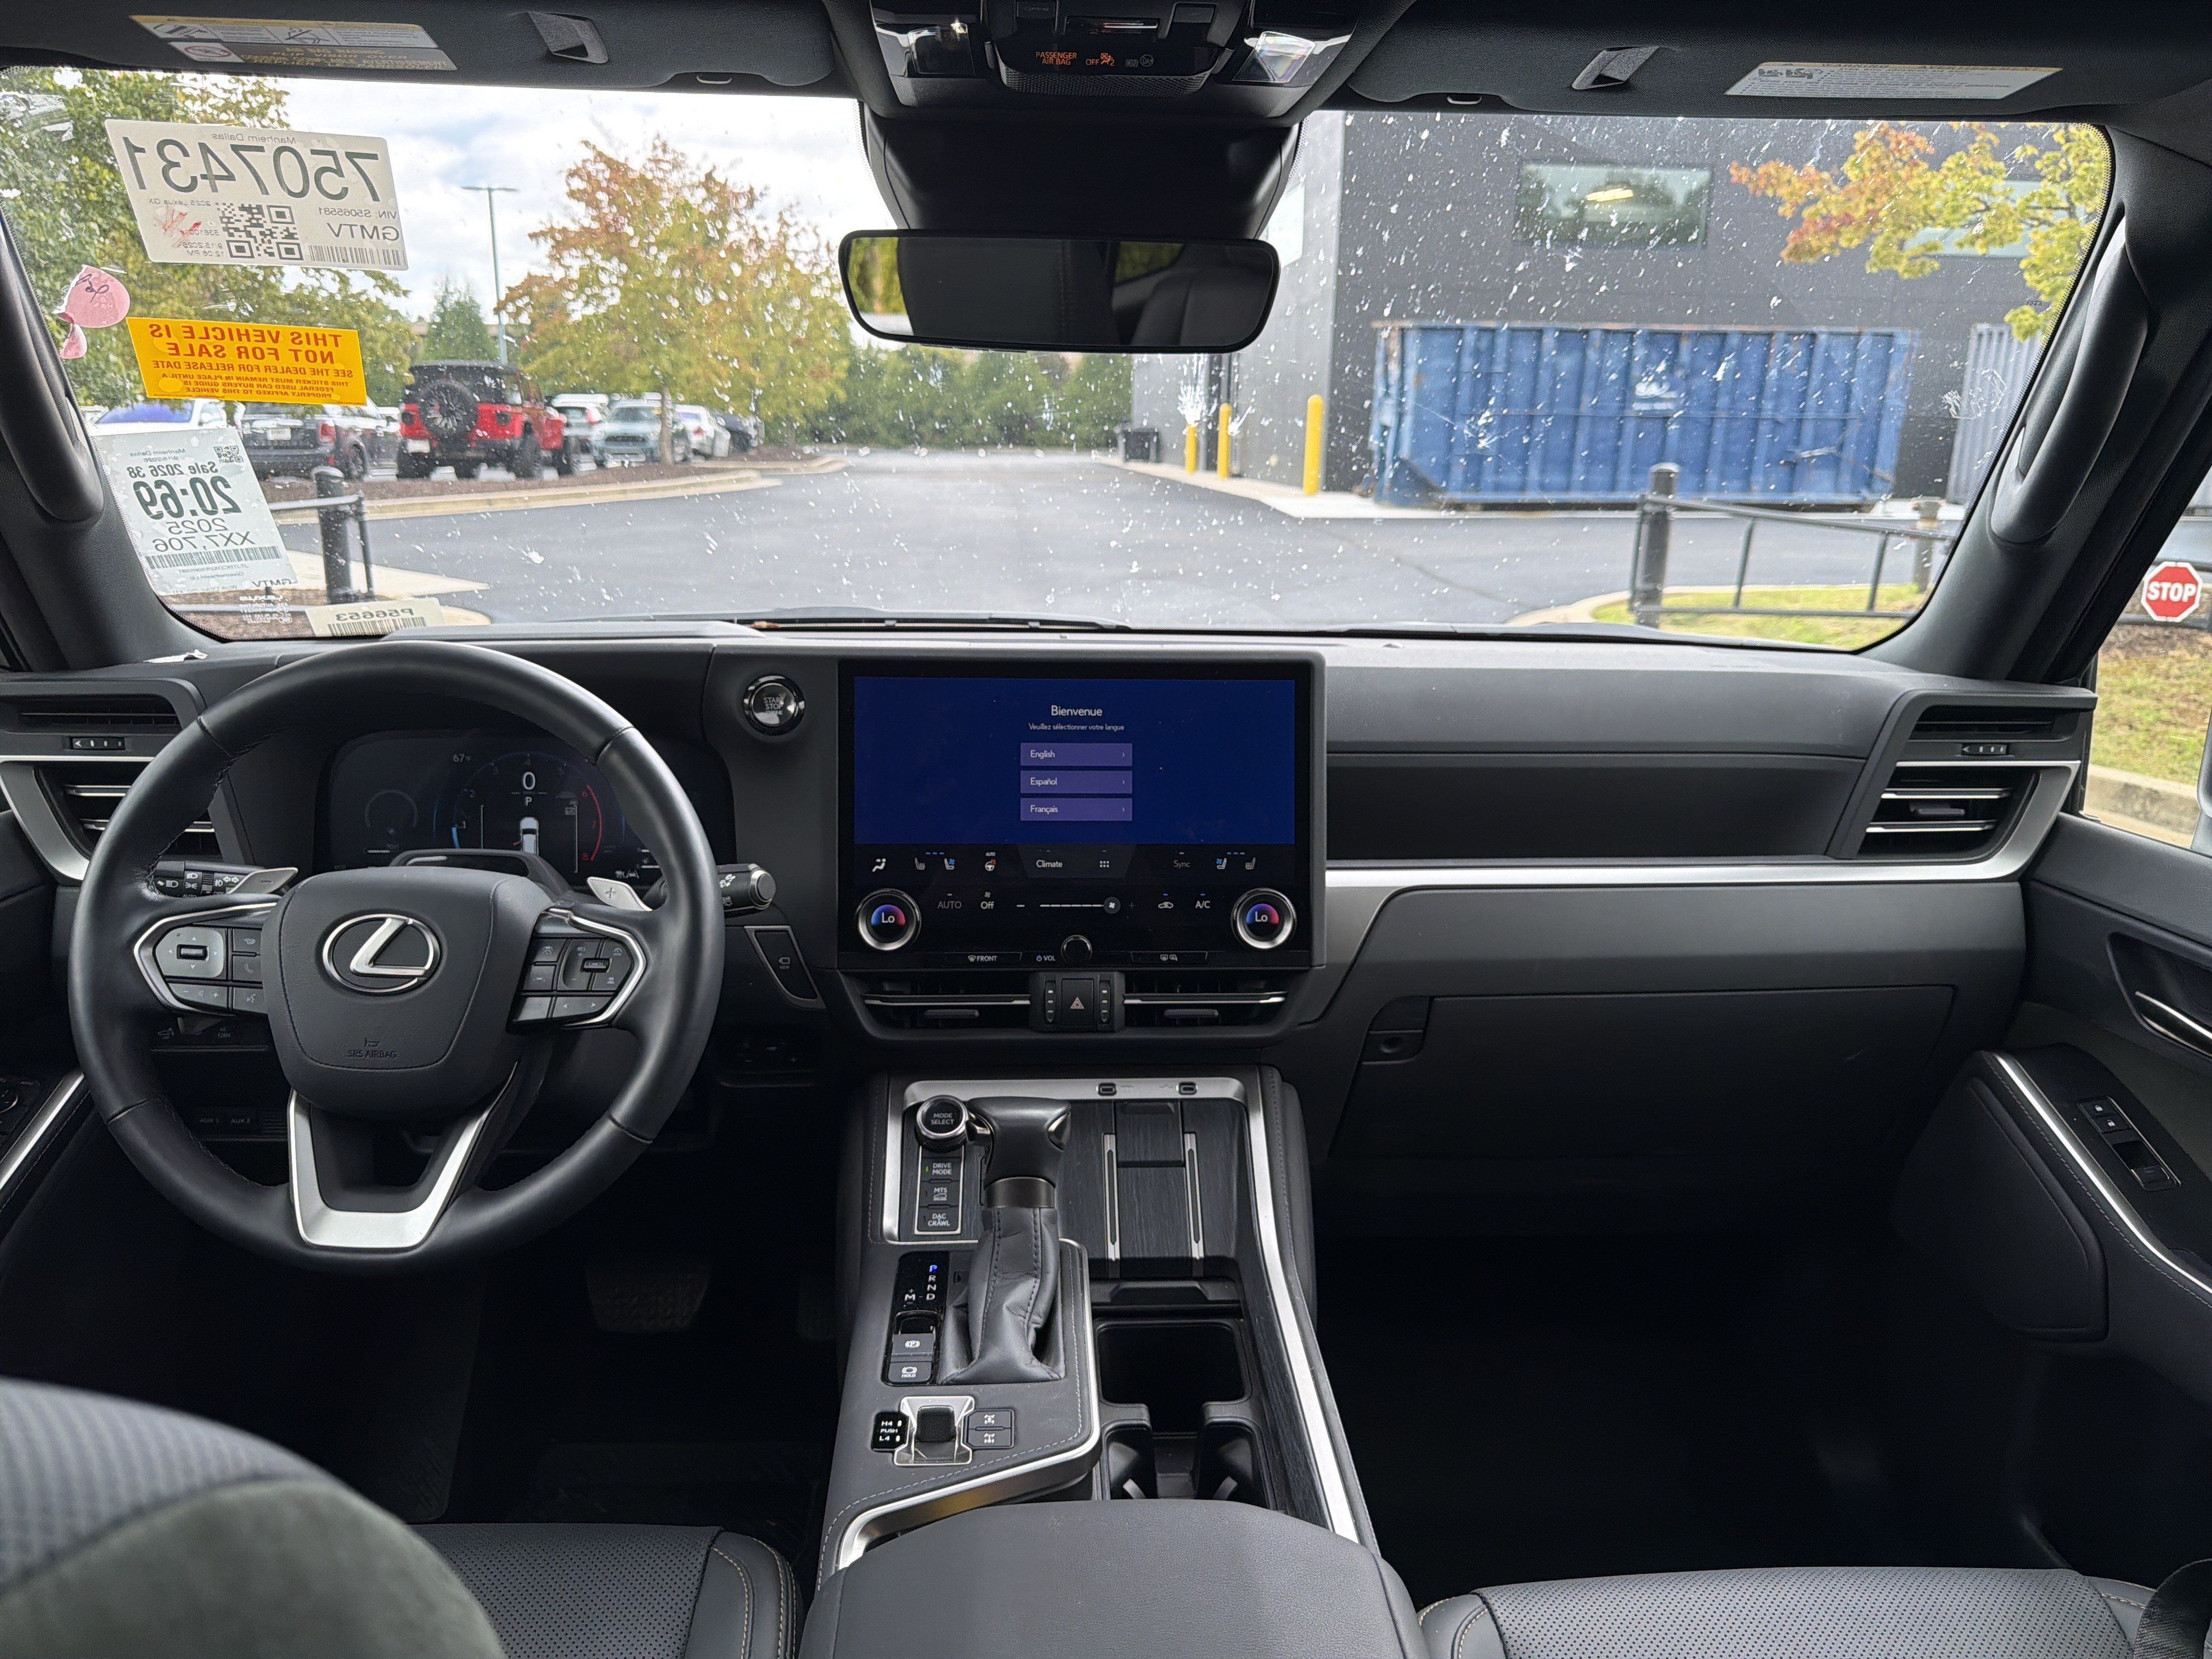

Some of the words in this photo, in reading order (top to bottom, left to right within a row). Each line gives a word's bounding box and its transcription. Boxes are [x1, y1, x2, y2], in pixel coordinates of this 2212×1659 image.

[2147, 581, 2196, 602] STOP
[1051, 704, 1103, 716] Bienvenue
[1105, 724, 1125, 732] langue
[1030, 749, 1055, 759] English
[523, 771, 535, 791] 0
[1030, 777, 1058, 787] Español
[525, 797, 533, 806] P
[1030, 804, 1059, 815] Français
[1036, 859, 1063, 868] Climate
[1173, 860, 1190, 868] Sync
[937, 901, 962, 909] AUTO
[980, 901, 995, 910] Off
[1195, 901, 1210, 909] A/C
[881, 912, 895, 923] Lo
[1255, 911, 1268, 922] Lo
[348, 1049, 363, 1058] SRS
[364, 1049, 397, 1059] AIRBAG
